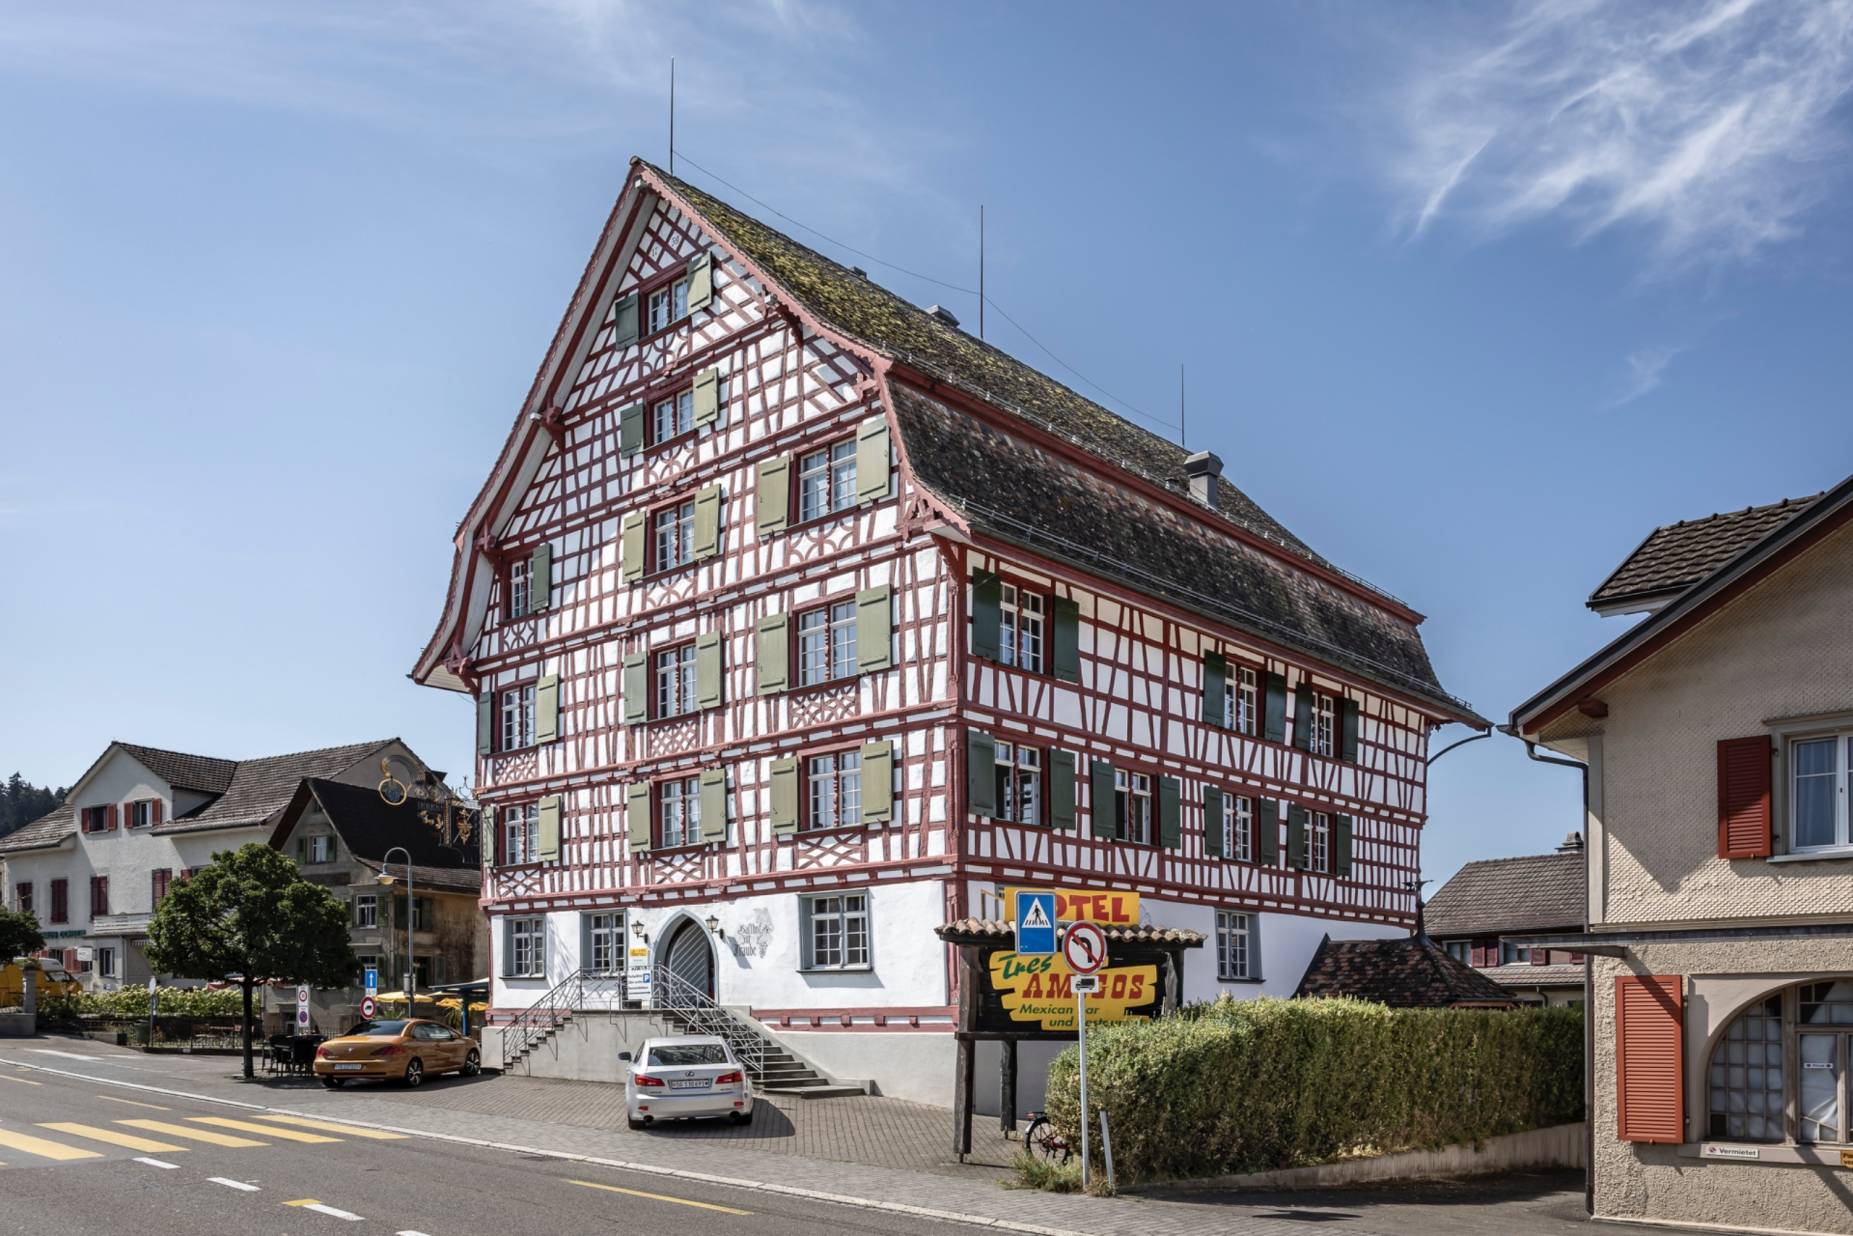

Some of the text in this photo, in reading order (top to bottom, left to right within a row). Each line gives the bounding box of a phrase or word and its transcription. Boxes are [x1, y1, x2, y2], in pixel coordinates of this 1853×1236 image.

[1055, 894, 1130, 923] OTEL
[998, 953, 1053, 980] Tres
[1022, 973, 1145, 999] AMGOS
[1019, 1004, 1073, 1015] Mexican
[1049, 1016, 1074, 1027] und
[1719, 1147, 1756, 1156] Vermietet
